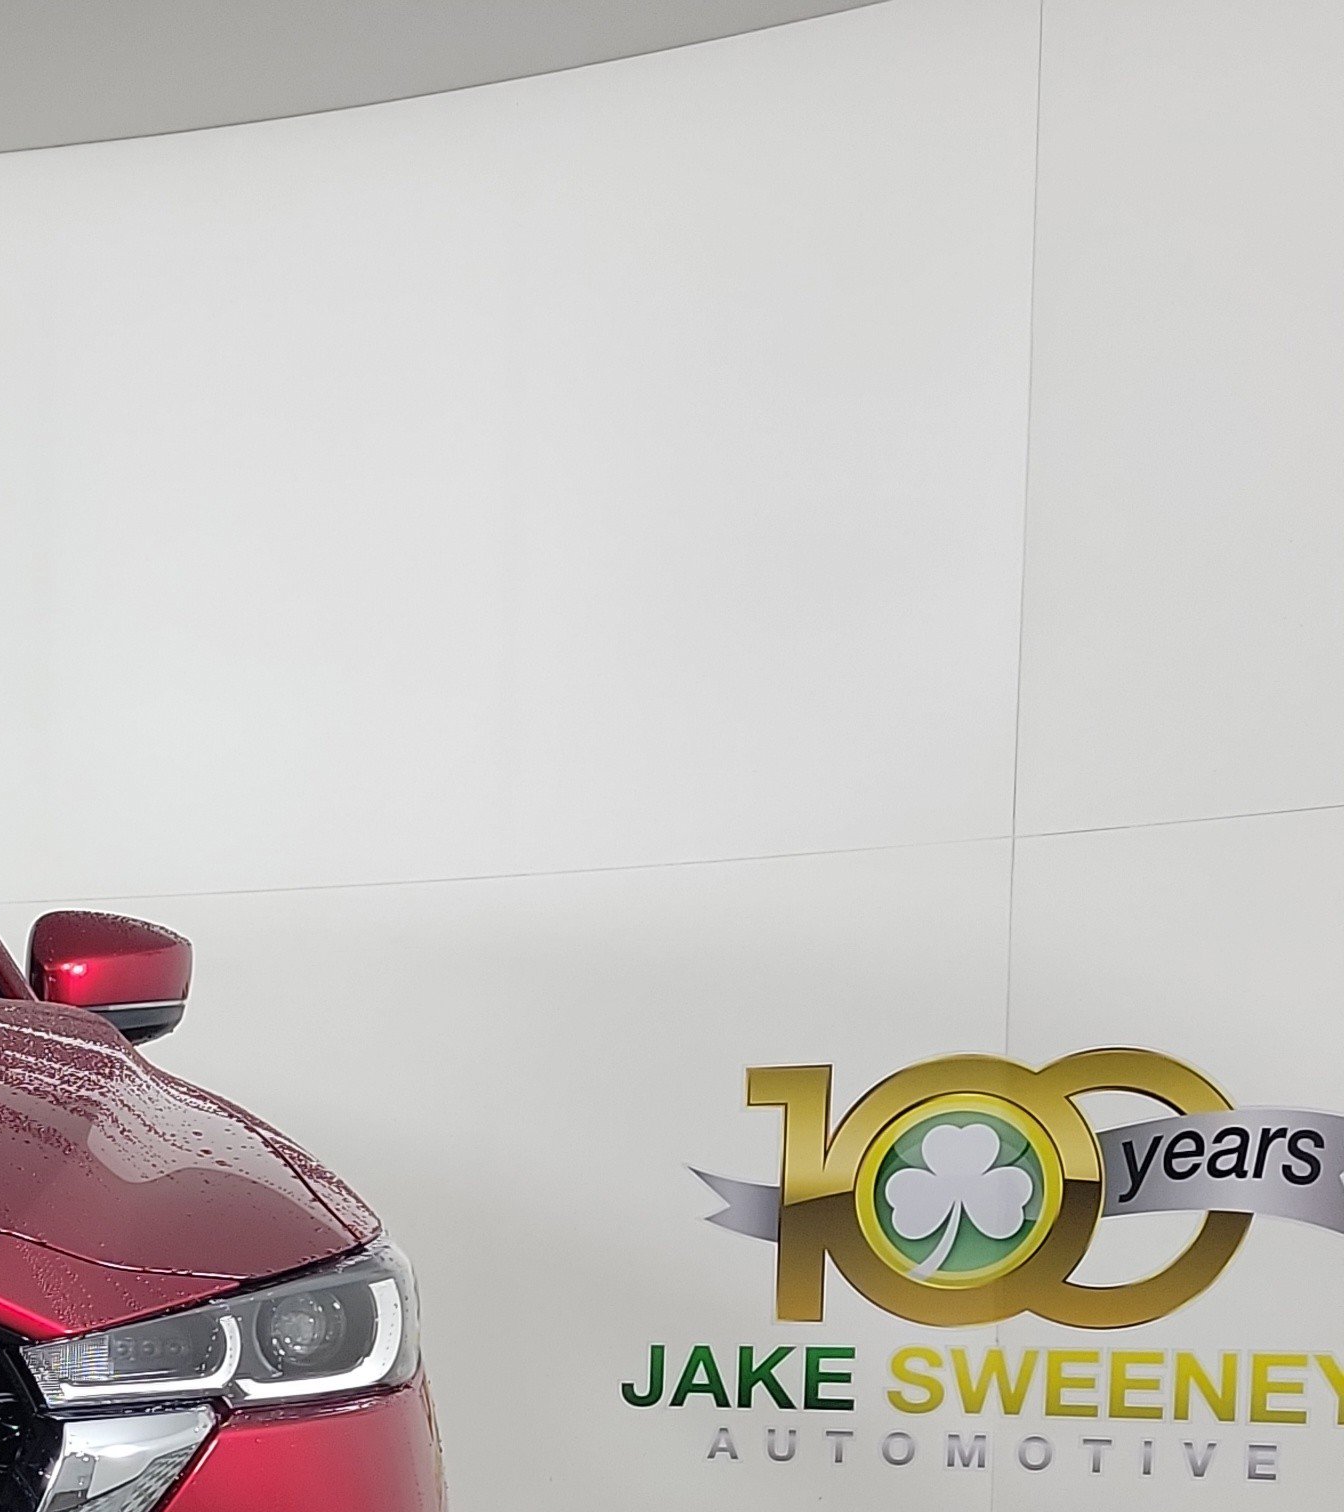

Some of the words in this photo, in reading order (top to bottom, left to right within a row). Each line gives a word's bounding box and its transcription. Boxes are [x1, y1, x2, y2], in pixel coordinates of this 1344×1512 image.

[746, 1046, 1255, 1328] 100
[1117, 1125, 1326, 1202] years
[620, 1344, 856, 1411] JAKE
[707, 1427, 1278, 1481] AUTOMOTIVE
